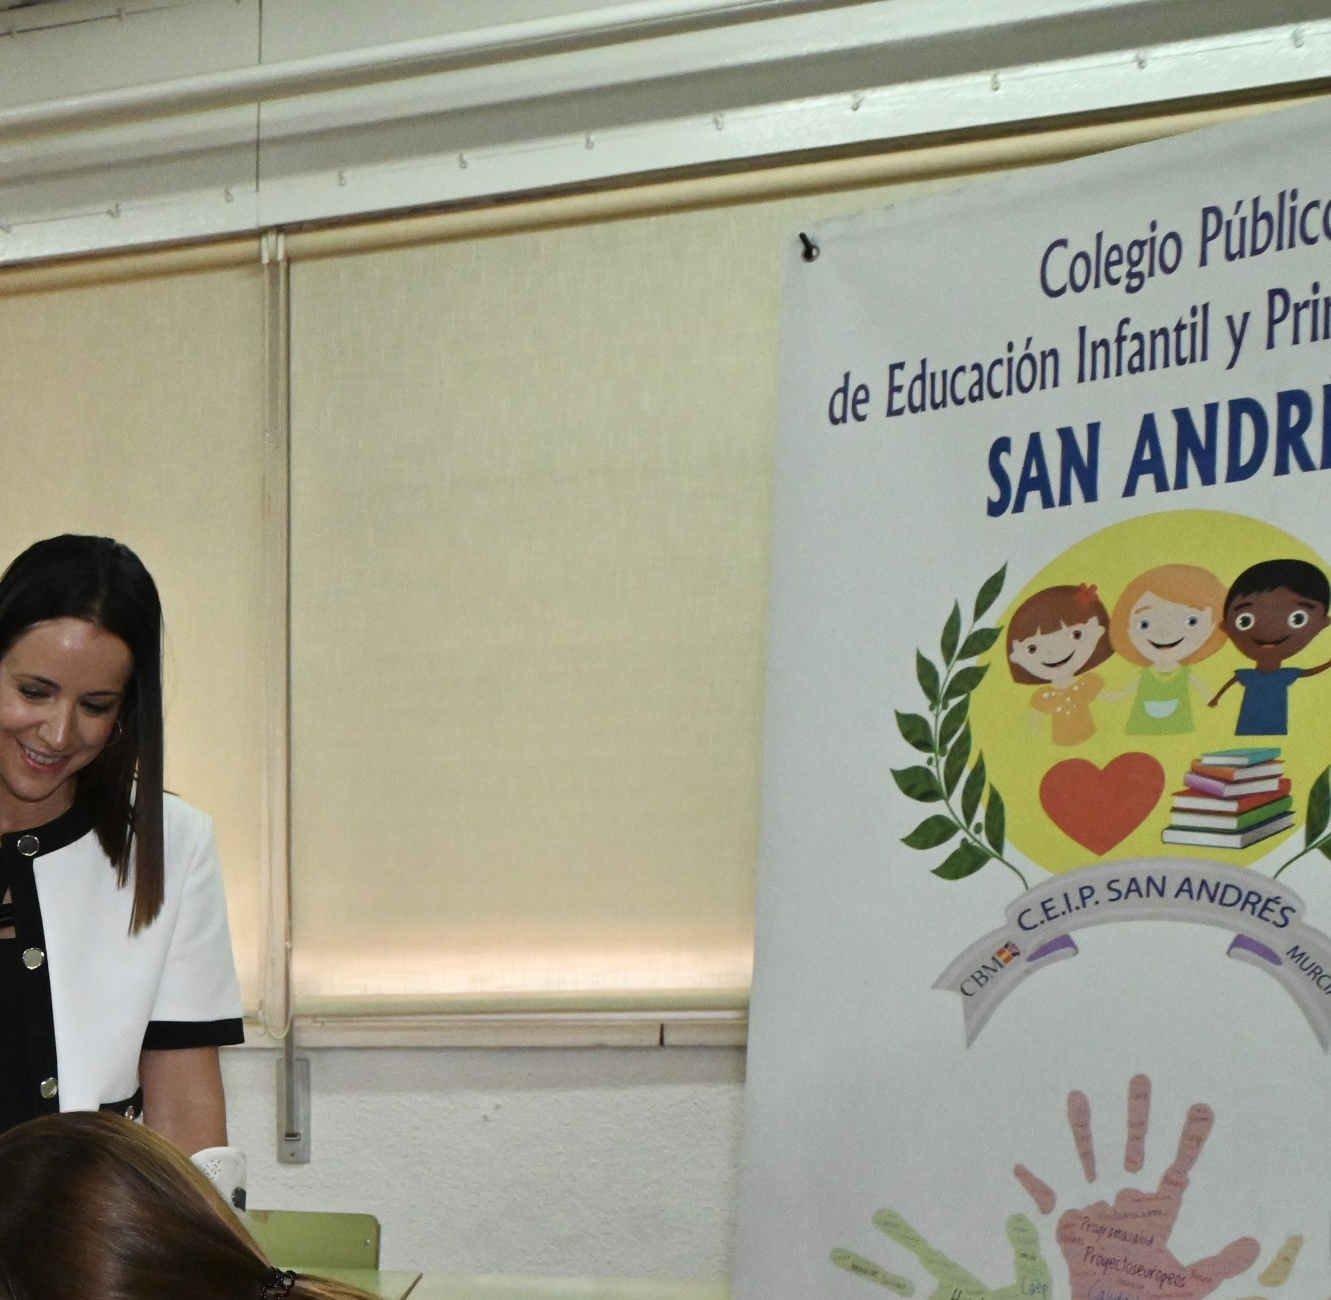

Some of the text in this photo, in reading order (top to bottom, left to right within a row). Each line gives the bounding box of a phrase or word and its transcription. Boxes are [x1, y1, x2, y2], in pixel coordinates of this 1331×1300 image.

[1039, 221, 1183, 299] Colegio
[827, 281, 1331, 426] de Educación Infantil y Pri
[985, 421, 1102, 518] SAN
[1017, 875, 1297, 931] C.E.I.P. SAN ANDRÉS
[960, 956, 1004, 998] CBM
[1083, 1245, 1186, 1289] Proyectoseuropeos
